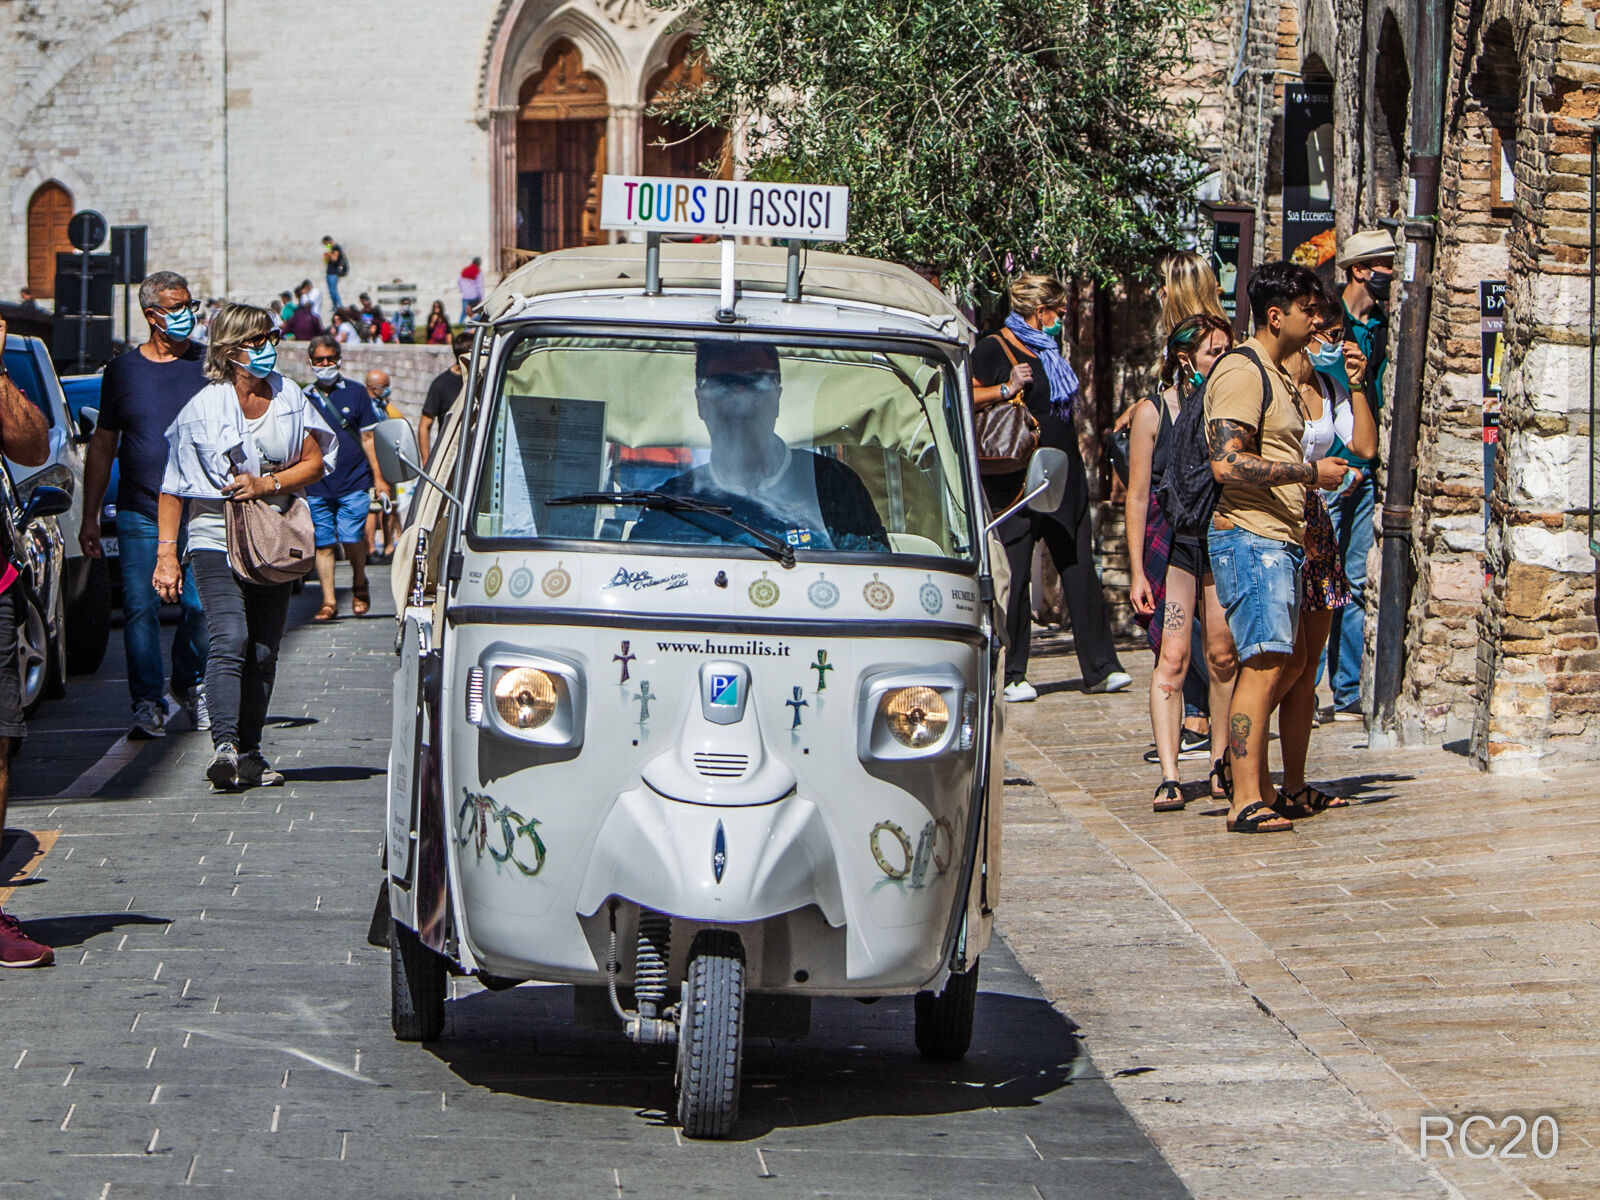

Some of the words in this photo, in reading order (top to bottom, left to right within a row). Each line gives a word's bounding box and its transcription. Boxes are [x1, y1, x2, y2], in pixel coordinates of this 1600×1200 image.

[624, 182, 707, 224] TOURS
[715, 186, 738, 225] DI
[749, 188, 831, 229] ASSISI
[656, 638, 791, 657] www.humilis.it
